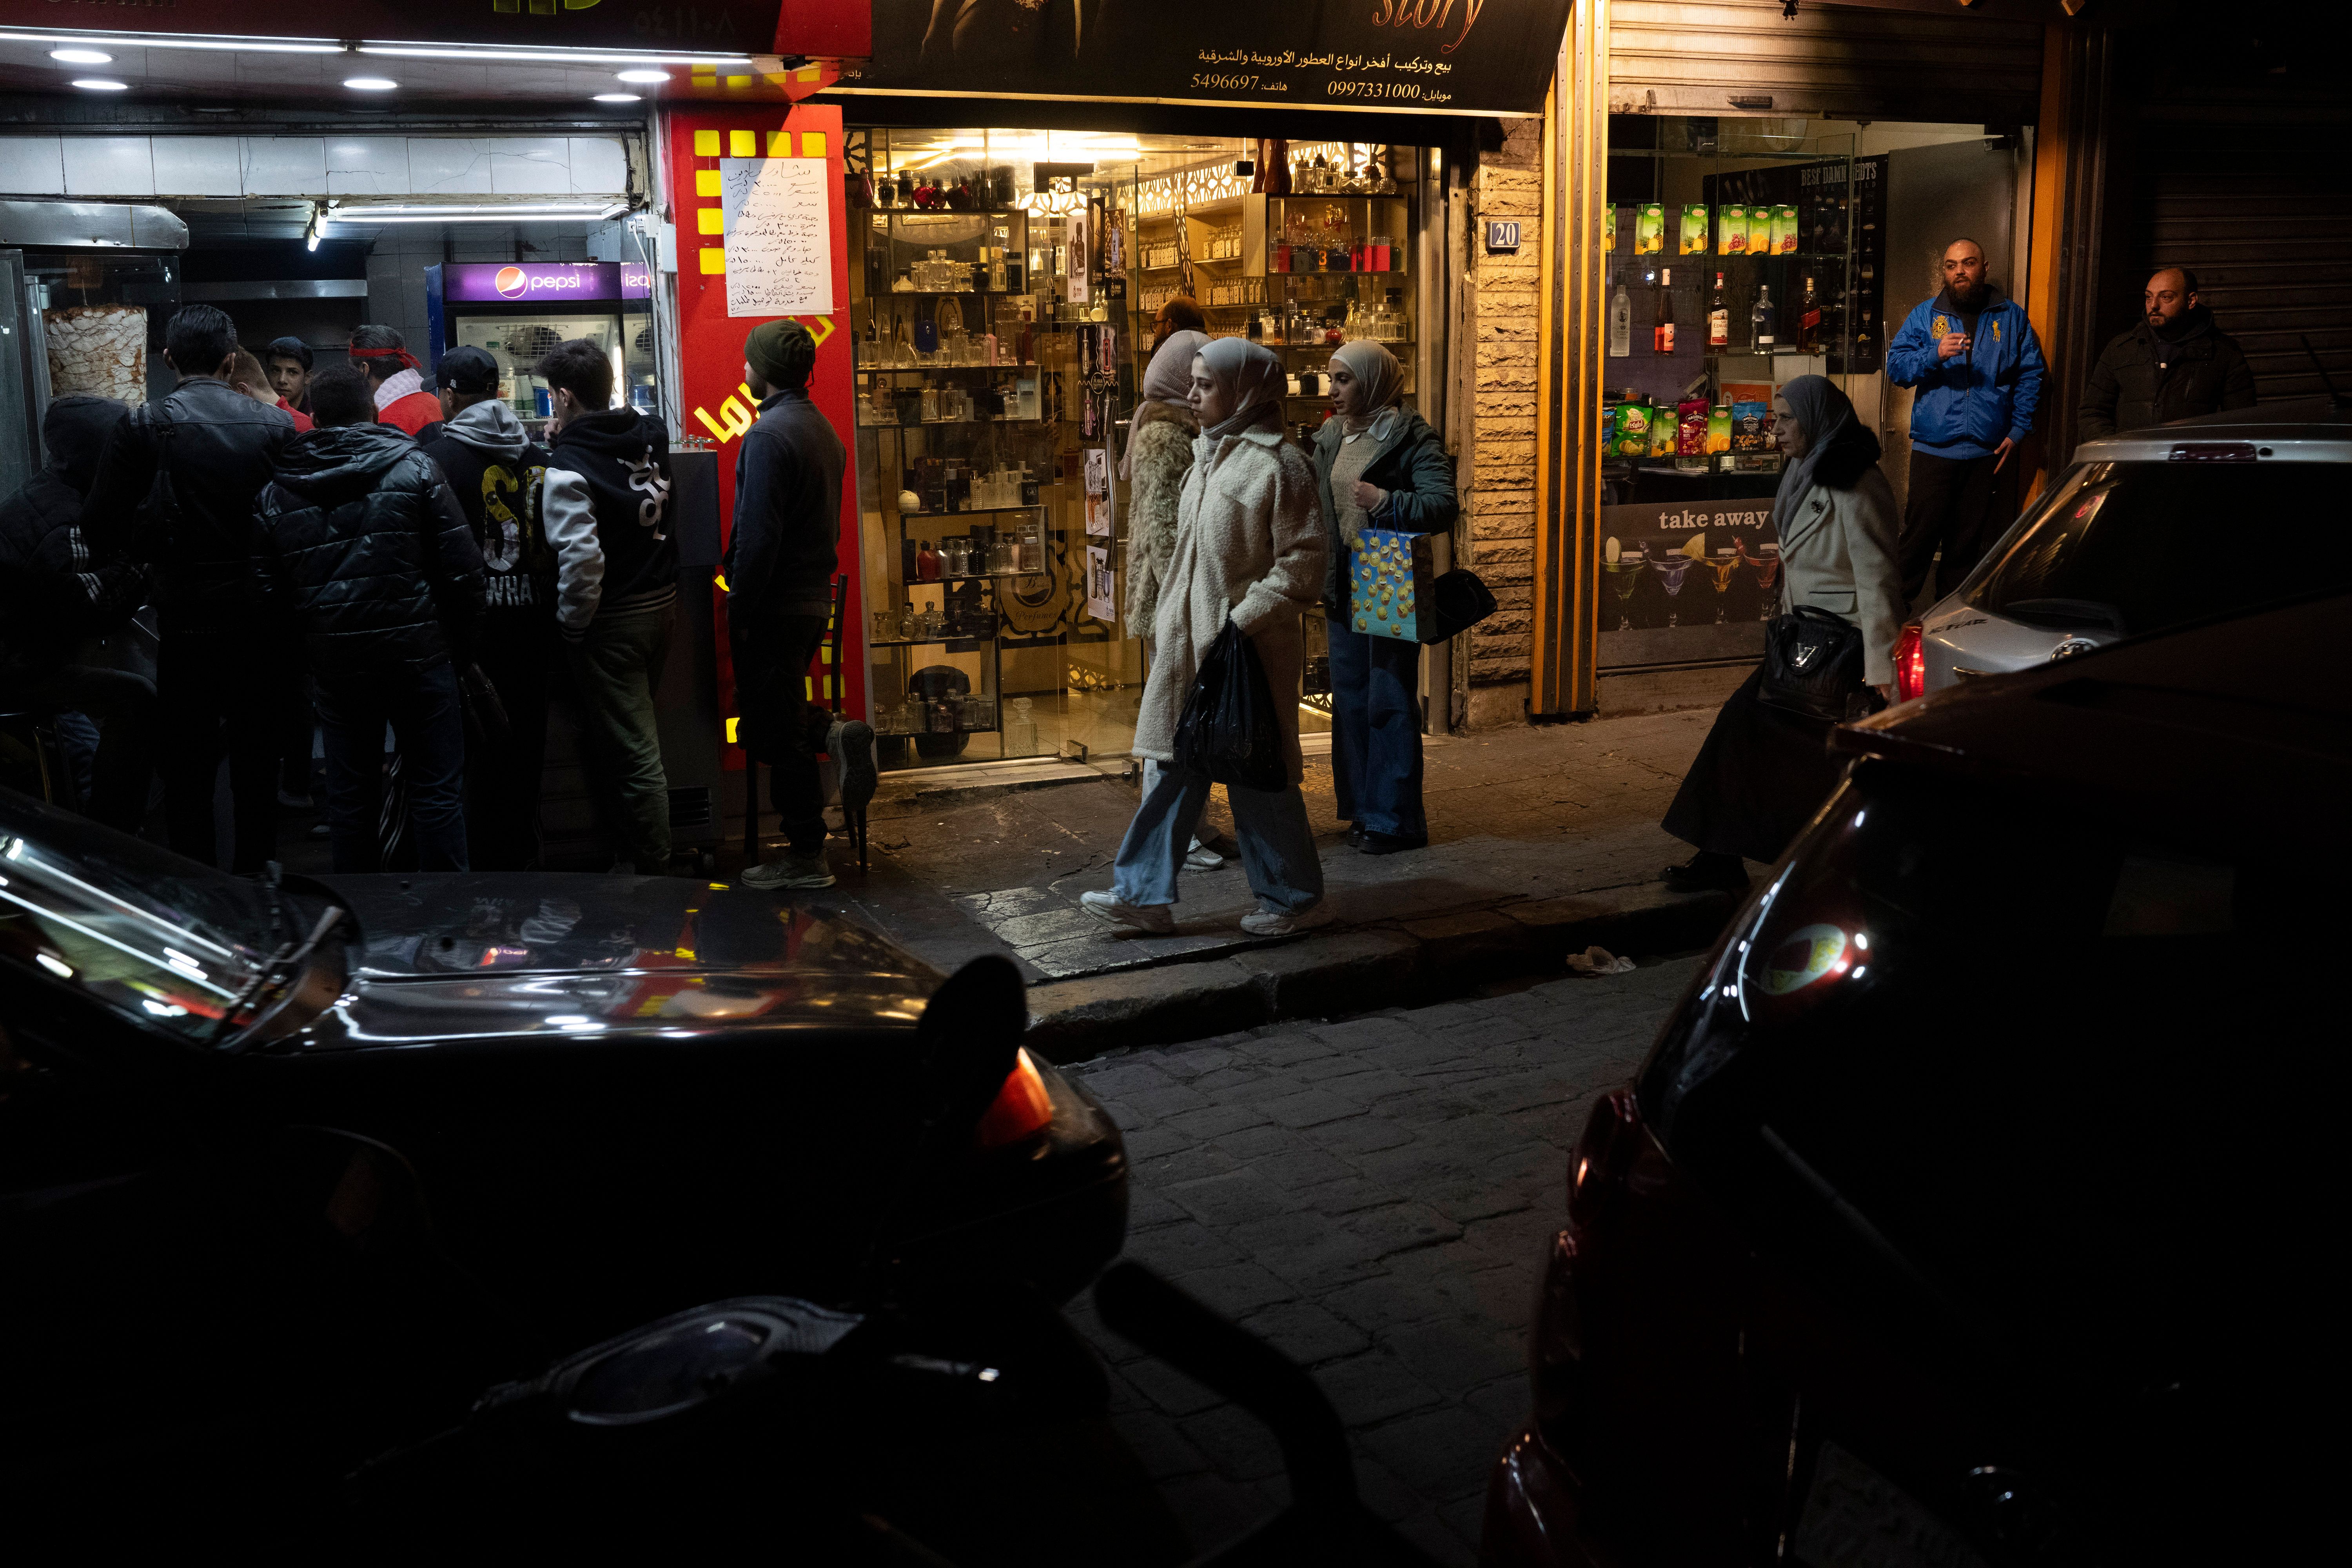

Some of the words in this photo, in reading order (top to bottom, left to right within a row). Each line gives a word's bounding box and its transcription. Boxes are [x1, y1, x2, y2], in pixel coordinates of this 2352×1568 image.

[1199, 49, 1248, 65] والشرقية
[1251, 49, 1295, 66] الأوروبية
[1294, 52, 1334, 68] العطور
[1336, 54, 1362, 71] انواع
[1362, 53, 1390, 71] أفخر
[1395, 56, 1432, 74] وتركيب
[1434, 62, 1452, 76] بيع
[1191, 73, 1259, 90] 5496697
[1261, 81, 1287, 91] هاتف:
[1327, 81, 1420, 98] 0997331000
[1422, 90, 1452, 102] موبايل:
[1822, 164, 1847, 184] DAMN
[1495, 223, 1516, 245] 20
[1319, 251, 1327, 265] 3
[531, 273, 581, 291] pepsi
[1659, 510, 1708, 529] take
[1714, 511, 1769, 530] away
[1014, 610, 1057, 623] Perfumes
